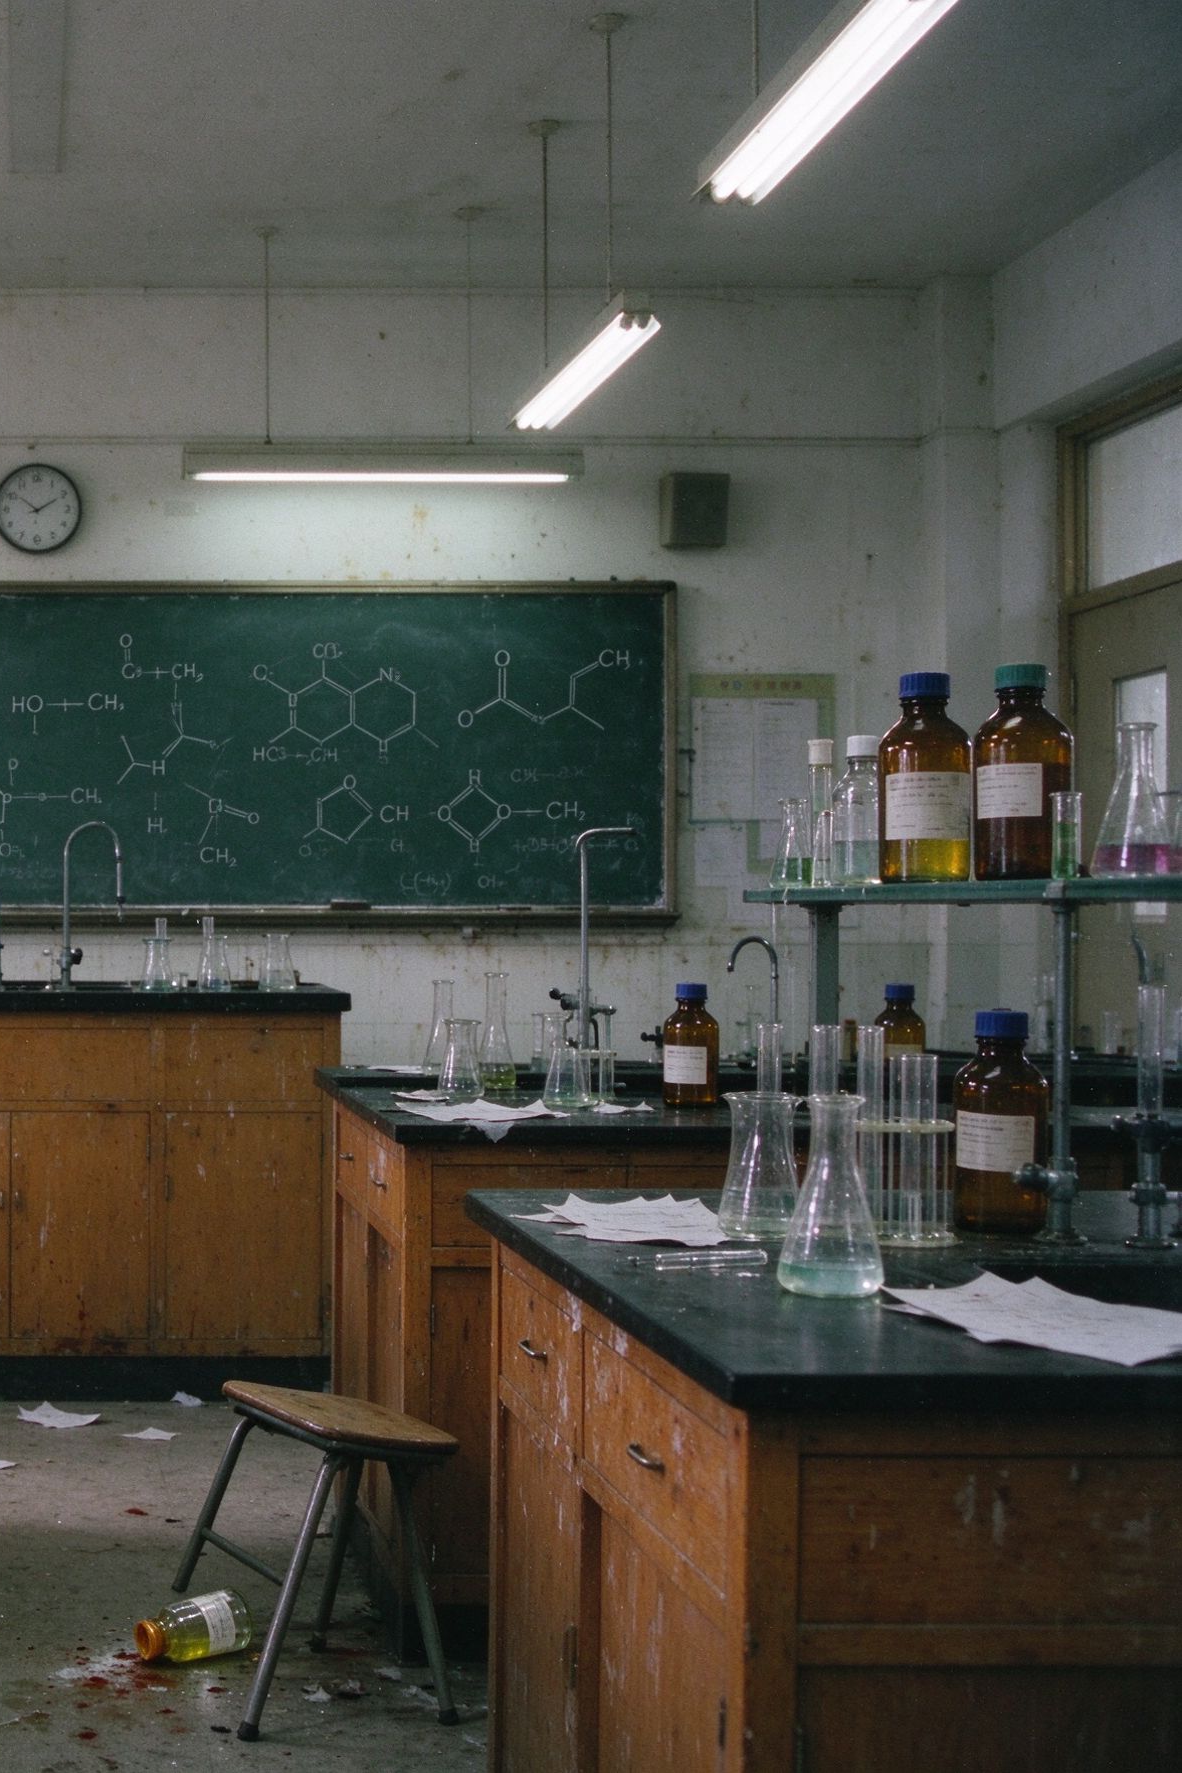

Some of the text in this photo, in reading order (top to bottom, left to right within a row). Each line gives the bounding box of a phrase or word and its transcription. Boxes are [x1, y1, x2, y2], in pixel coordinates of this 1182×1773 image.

[494, 649, 511, 667] O
[12, 694, 44, 713] HO
[457, 709, 474, 728] O
[343, 774, 357, 790] O
[379, 804, 410, 823] CH
[437, 800, 586, 822] O O CH2
[199, 846, 237, 868] CH2
